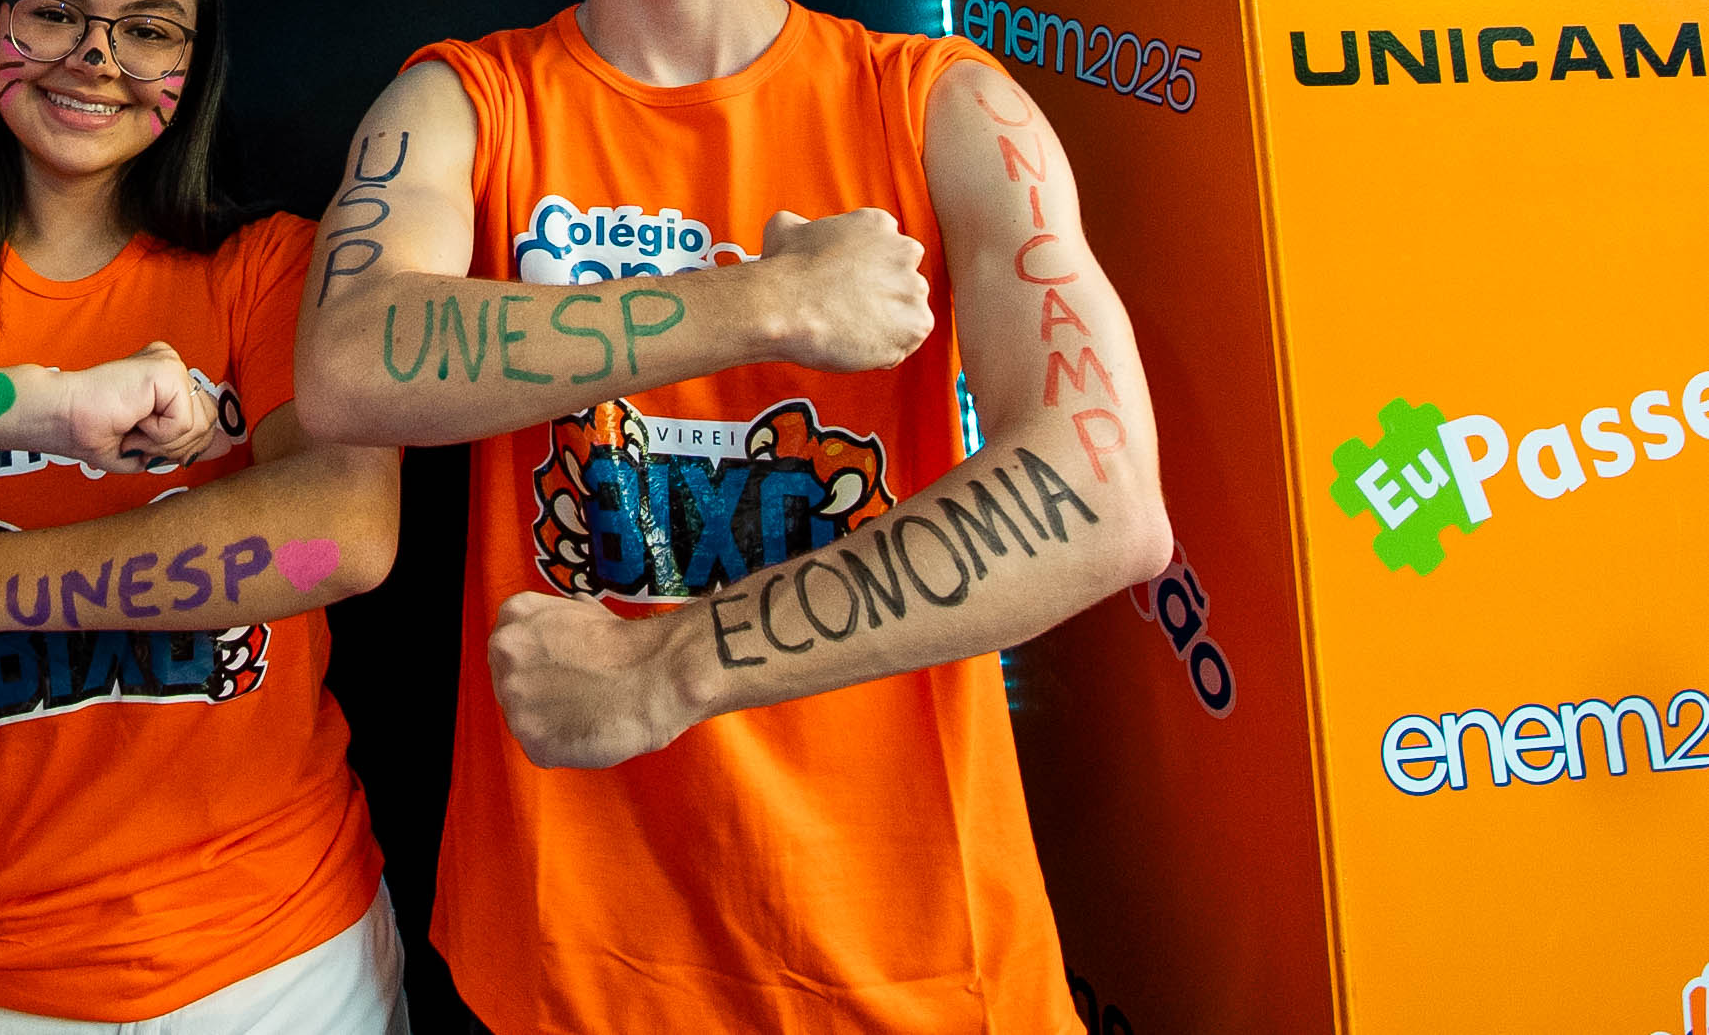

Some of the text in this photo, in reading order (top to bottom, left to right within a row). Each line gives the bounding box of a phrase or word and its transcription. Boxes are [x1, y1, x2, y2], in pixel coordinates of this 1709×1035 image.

[1288, 22, 1708, 87] UNICAM
[317, 130, 409, 307] USP
[535, 204, 704, 260] Colégio
[976, 86, 1127, 483] UNICAMP
[383, 289, 686, 384] UNESP
[656, 426, 736, 446] VIREI
[1354, 448, 1451, 531] Eu
[5, 536, 273, 629] UNESP
[710, 447, 1099, 669] ECONOMIA
[1382, 688, 1709, 796] enem2
